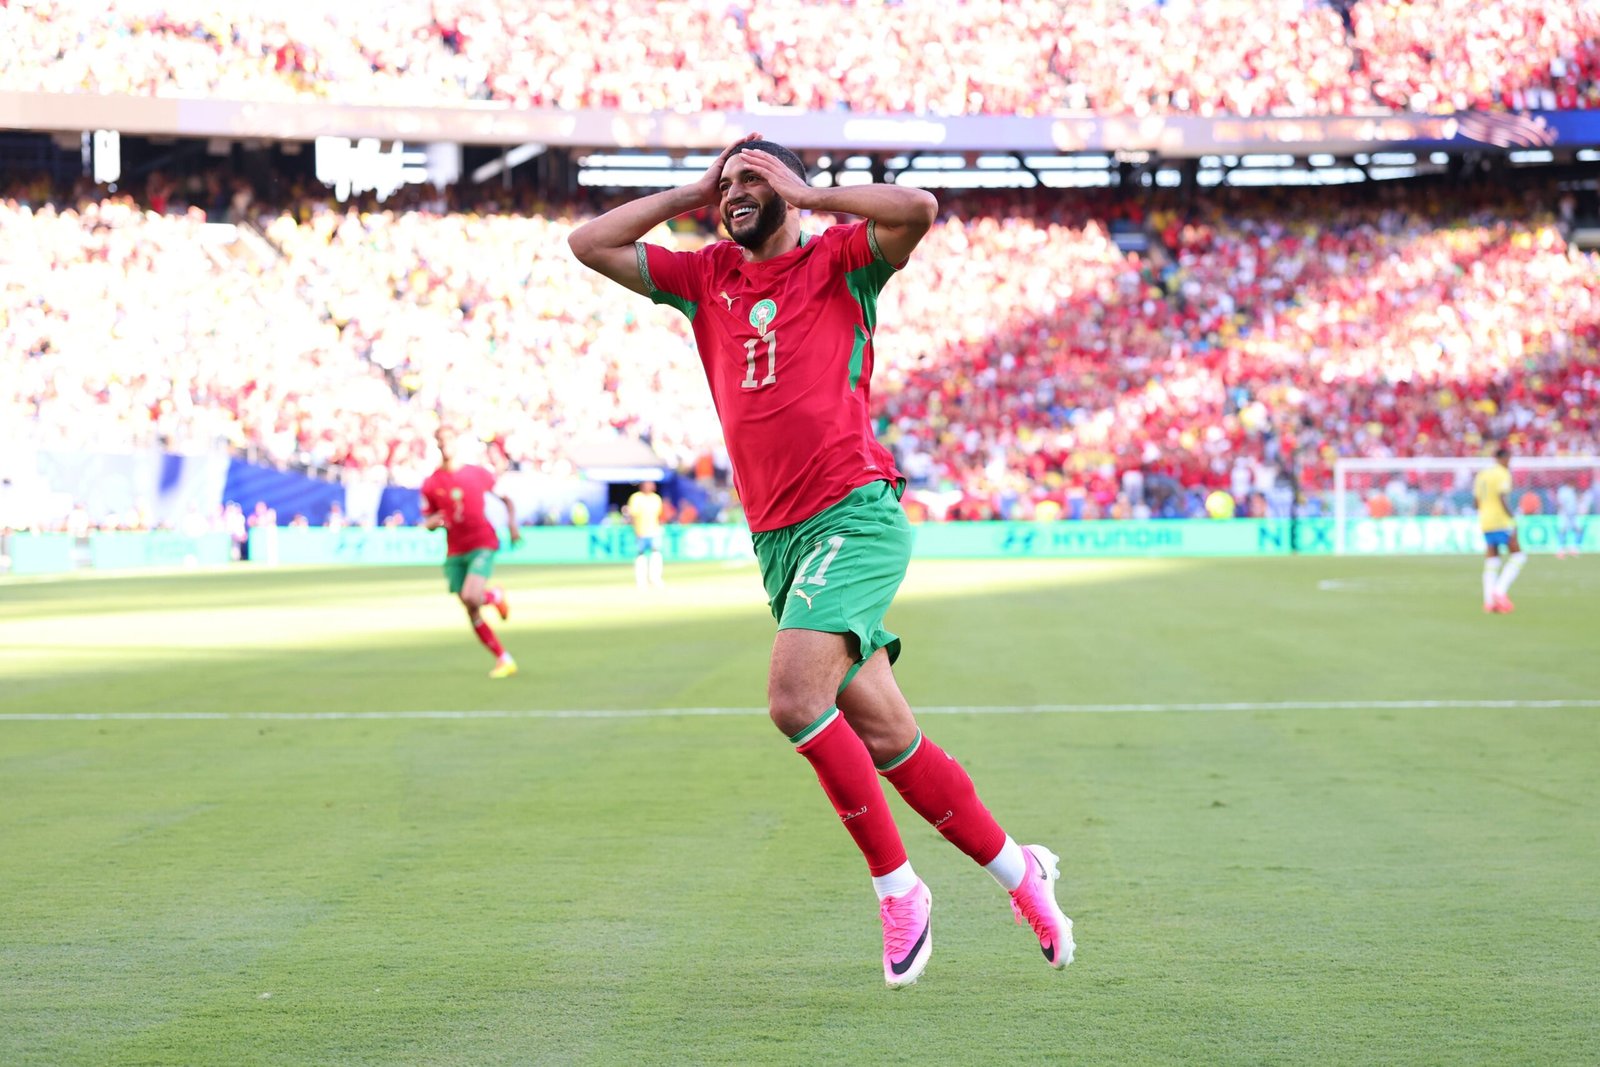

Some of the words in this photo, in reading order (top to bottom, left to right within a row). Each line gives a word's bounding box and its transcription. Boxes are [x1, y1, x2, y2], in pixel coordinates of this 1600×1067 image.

[741, 330, 776, 388] 11
[589, 527, 681, 557] NET
[1051, 528, 1182, 547] HYUNDAI
[792, 537, 845, 586] 11
